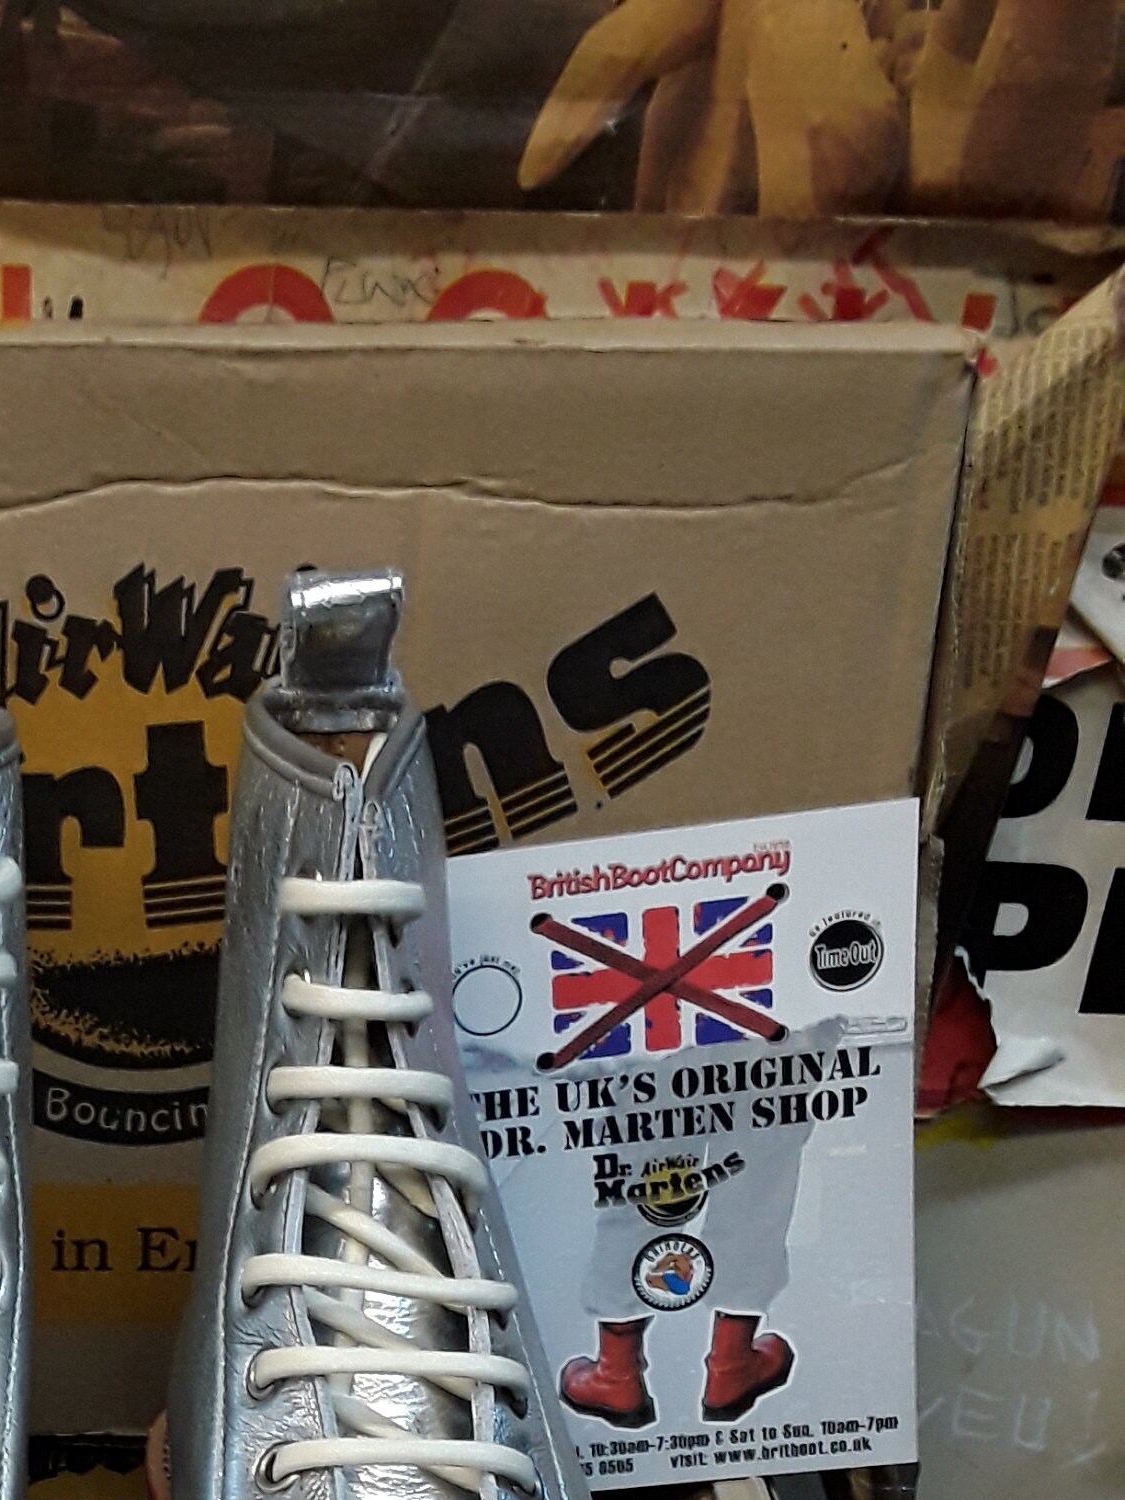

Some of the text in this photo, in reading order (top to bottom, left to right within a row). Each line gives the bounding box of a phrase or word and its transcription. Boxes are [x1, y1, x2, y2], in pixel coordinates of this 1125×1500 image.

[471, 1047, 882, 1121] HE UK'S ORIGINAL
[563, 1102, 736, 1150] MARTEN
[751, 1086, 869, 1129] SHOP
[593, 1153, 632, 1180] Dr.
[594, 1151, 746, 1208] Martens
[51, 1229, 112, 1271] in
